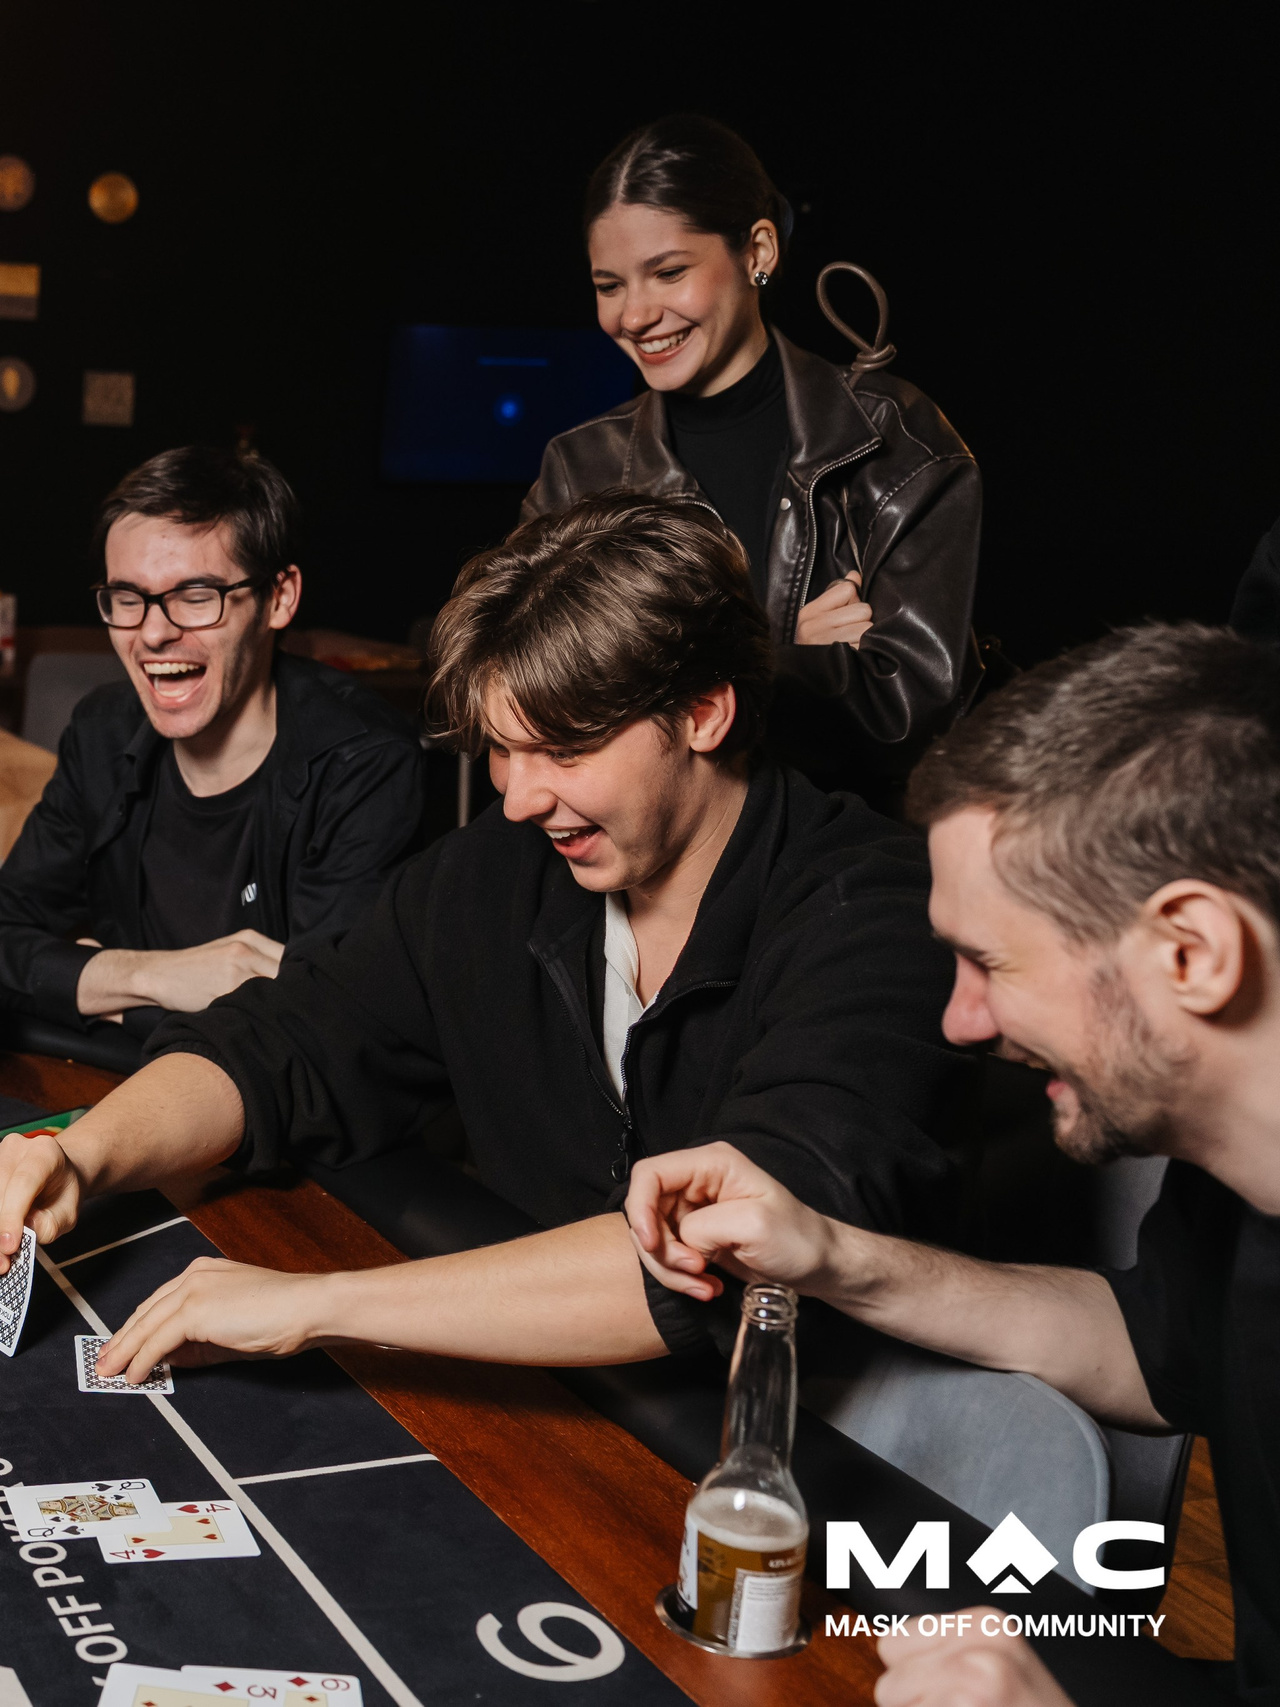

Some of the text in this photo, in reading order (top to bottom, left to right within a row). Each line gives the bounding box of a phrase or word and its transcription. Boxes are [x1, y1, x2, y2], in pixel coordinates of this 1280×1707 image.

[119, 1481, 147, 1492] Q
[205, 1503, 231, 1514] 4
[27, 1525, 56, 1538] Q
[109, 1549, 137, 1561] 4
[46, 1595, 128, 1664] OFF
[247, 1684, 278, 1700] 3
